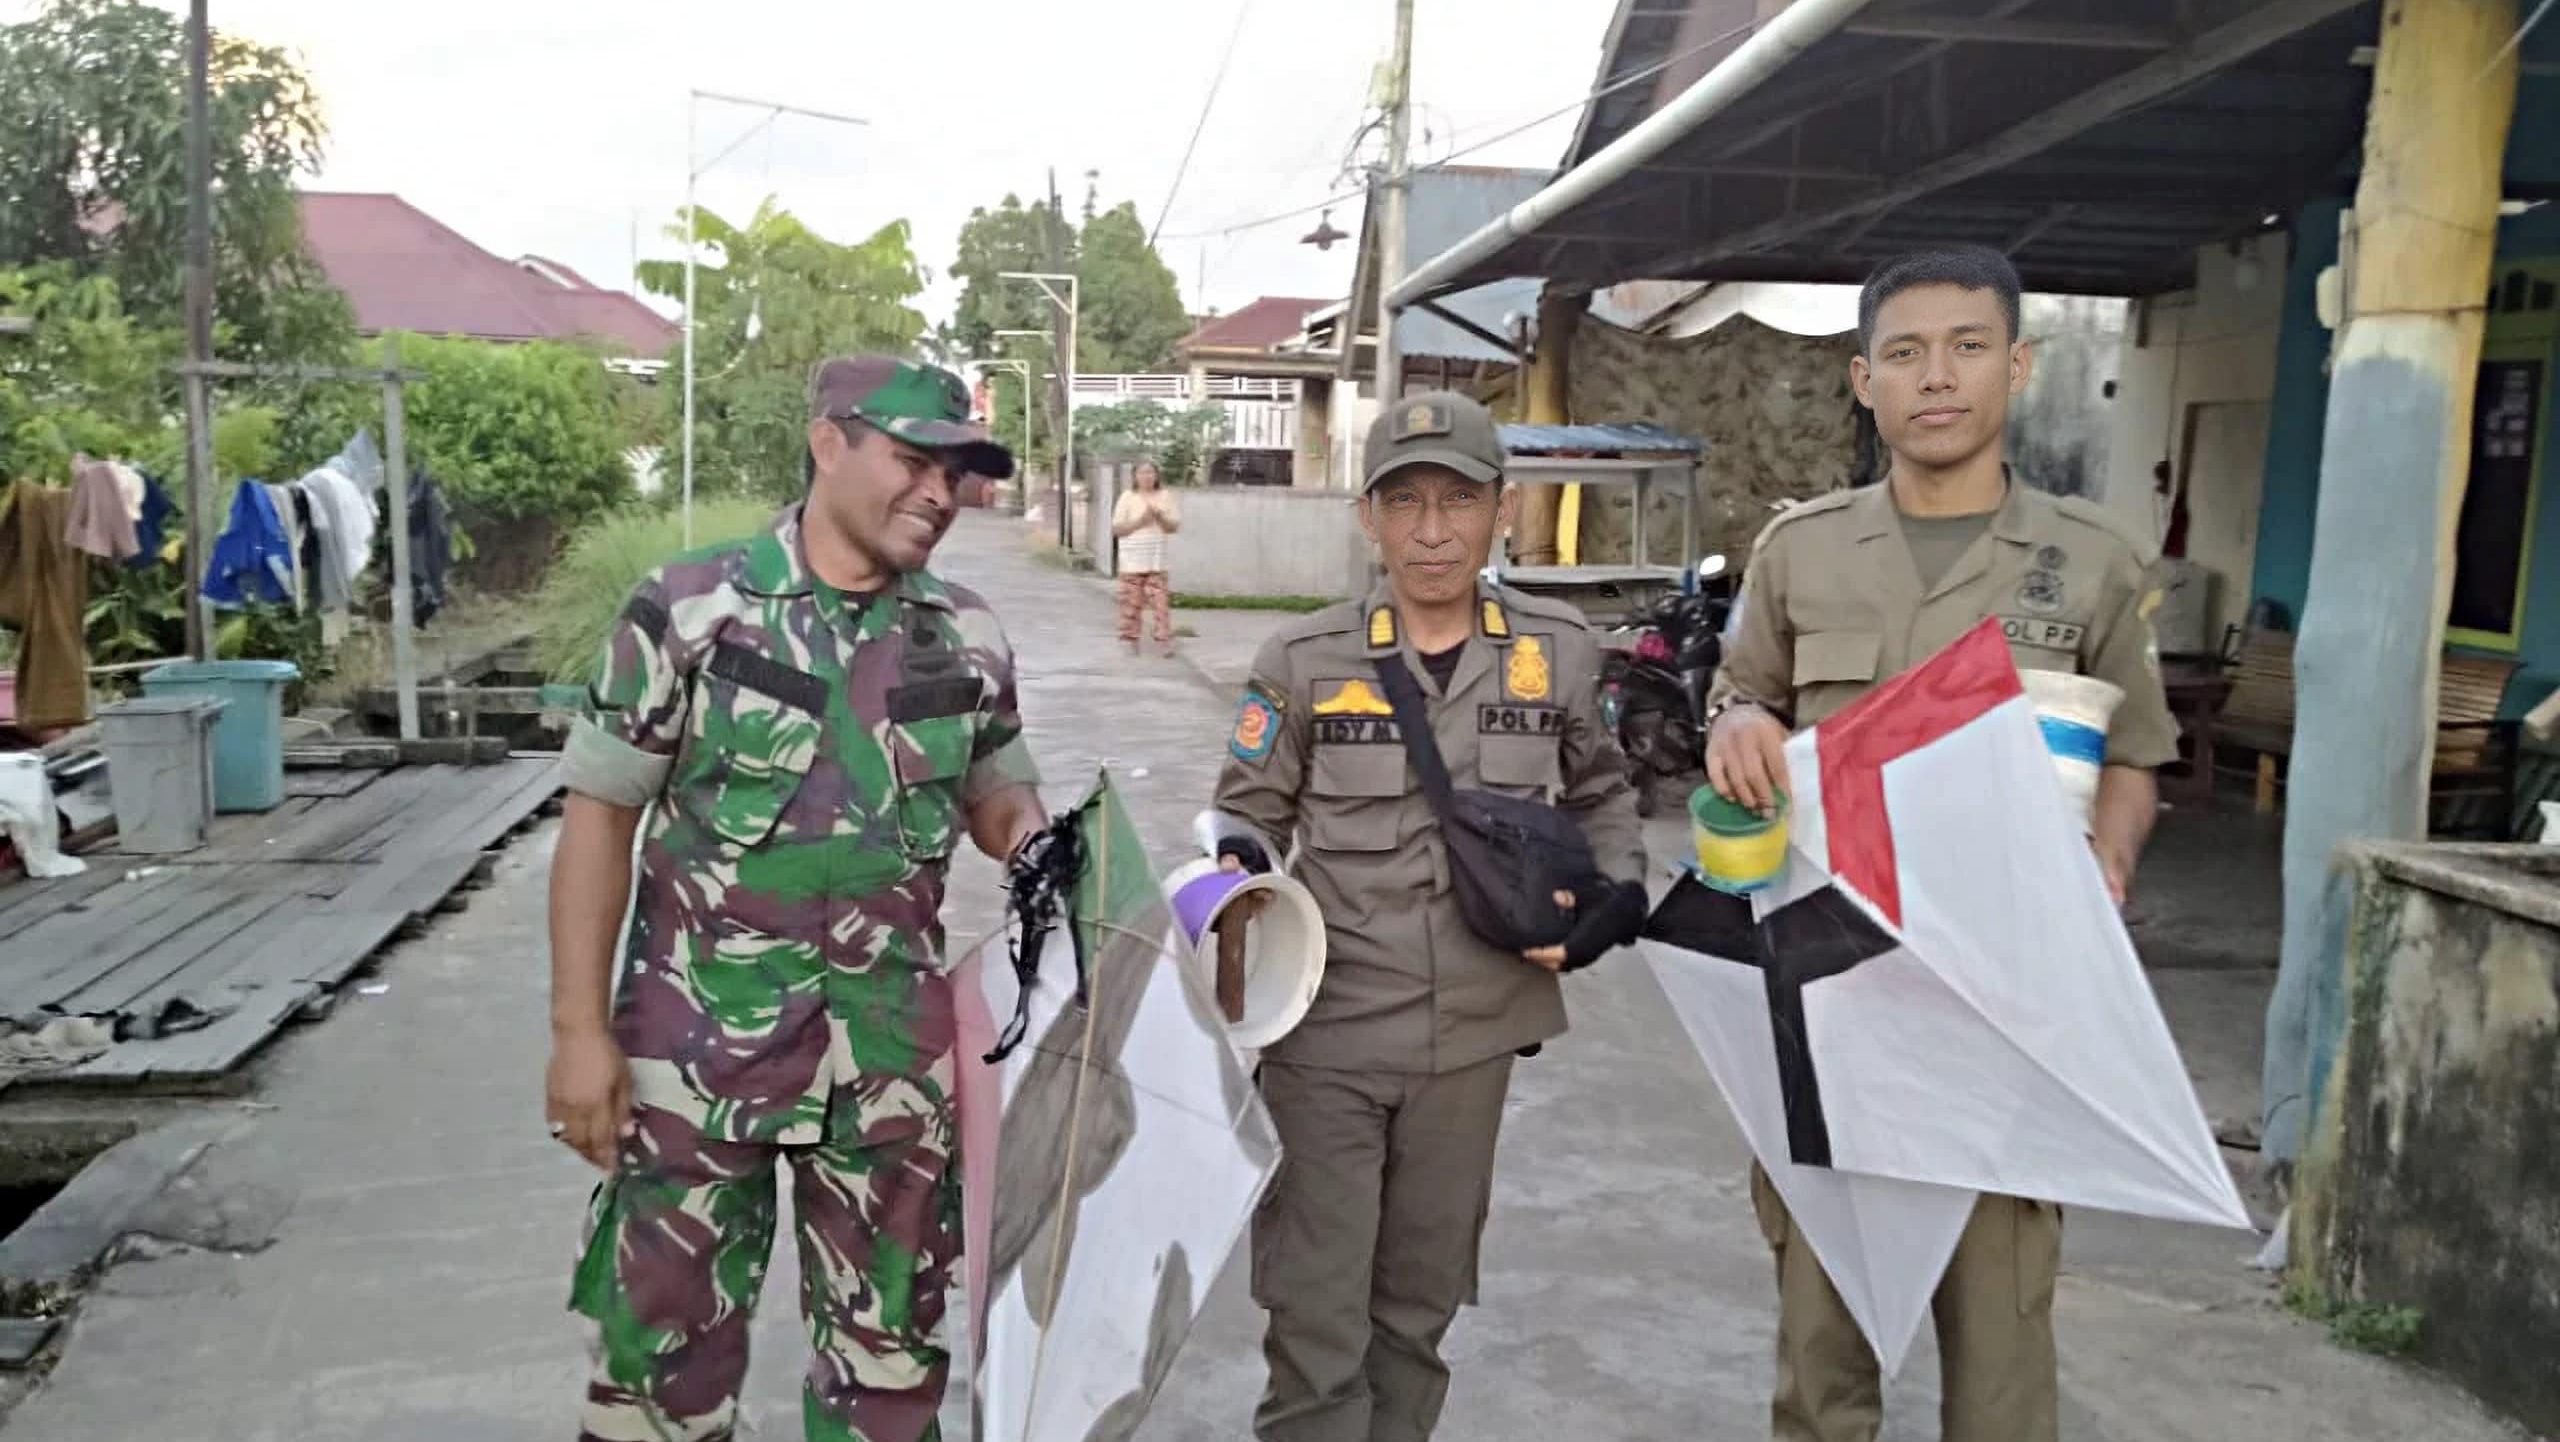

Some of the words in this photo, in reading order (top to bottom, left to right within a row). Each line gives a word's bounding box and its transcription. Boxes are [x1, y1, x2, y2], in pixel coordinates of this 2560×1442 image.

[2003, 620, 2036, 641] OL
[2045, 625, 2077, 643] PP
[1485, 708, 1531, 730] POL
